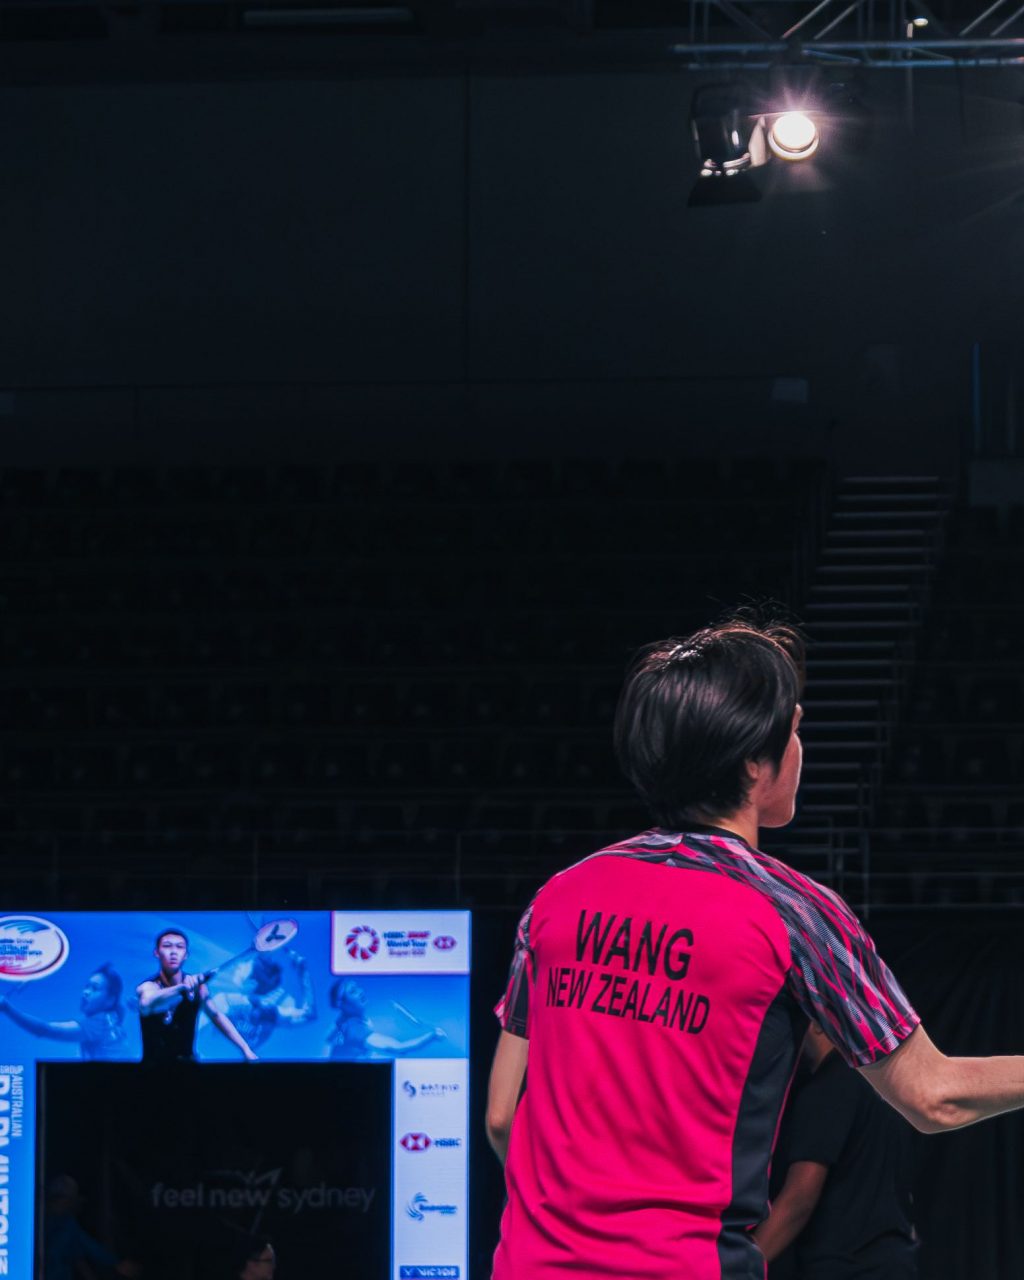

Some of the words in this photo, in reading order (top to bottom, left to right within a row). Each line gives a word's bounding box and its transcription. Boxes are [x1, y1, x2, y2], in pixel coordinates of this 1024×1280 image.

[576, 909, 694, 981] WANG
[546, 967, 594, 1010] NEW
[591, 973, 710, 1035] ZEALAND
[11, 1074, 24, 1137] AUSTRALIAN
[152, 1182, 204, 1207] feel
[209, 1187, 271, 1207] new
[277, 1182, 375, 1213] sydney
